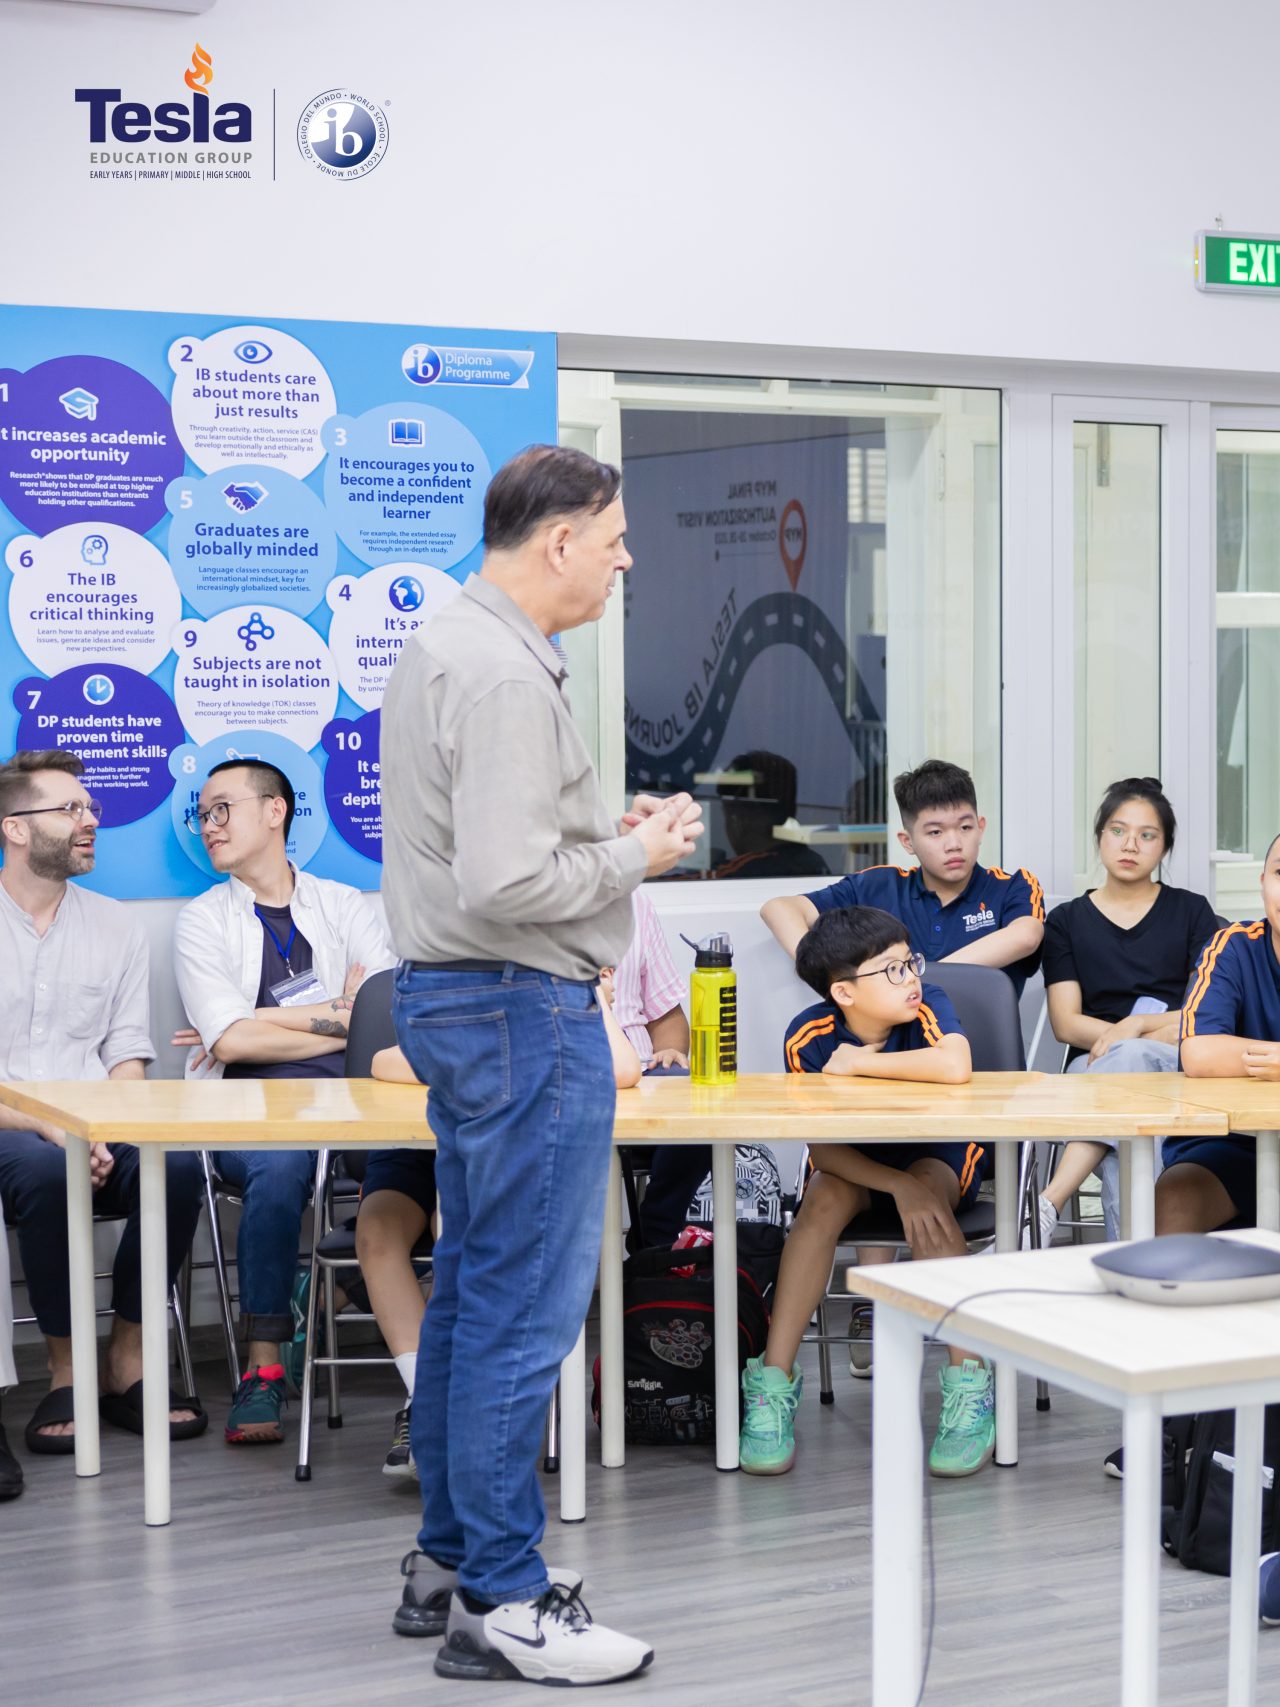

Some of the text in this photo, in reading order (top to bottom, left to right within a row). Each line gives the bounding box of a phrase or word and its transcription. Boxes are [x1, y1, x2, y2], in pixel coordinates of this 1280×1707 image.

[181, 345, 193, 362] 2
[445, 353, 492, 366] Diploma
[197, 368, 316, 385] IB students care
[445, 366, 510, 380] Programme
[0, 384, 8, 402] 1
[193, 386, 319, 402] about more than
[215, 404, 298, 419] just results
[12, 428, 87, 442] increases
[91, 431, 166, 445] academic
[335, 428, 347, 446] 3
[31, 448, 130, 464] opportunity
[340, 457, 474, 474] It encourages you to
[341, 473, 471, 488] become a confident
[180, 491, 193, 509] 5
[349, 490, 464, 505] and independent
[383, 507, 431, 519] learner
[195, 523, 309, 538] Graduates are
[186, 541, 318, 558] globally minded
[20, 550, 33, 568] 6
[68, 573, 115, 585] The IB
[47, 594, 137, 606] encourages
[339, 585, 352, 601] 4
[30, 608, 153, 624] critical thinking
[411, 621, 423, 630] a
[184, 631, 197, 647] 9
[194, 657, 321, 673] Subjects are not
[184, 675, 330, 691] taught in isolation
[28, 691, 41, 709] 7
[38, 715, 161, 727] DP students have
[57, 731, 144, 746] proven time
[336, 732, 361, 750] 10
[132, 745, 168, 758] skills
[183, 756, 196, 773] 8
[358, 760, 369, 773] It
[963, 910, 994, 926] Tesla
